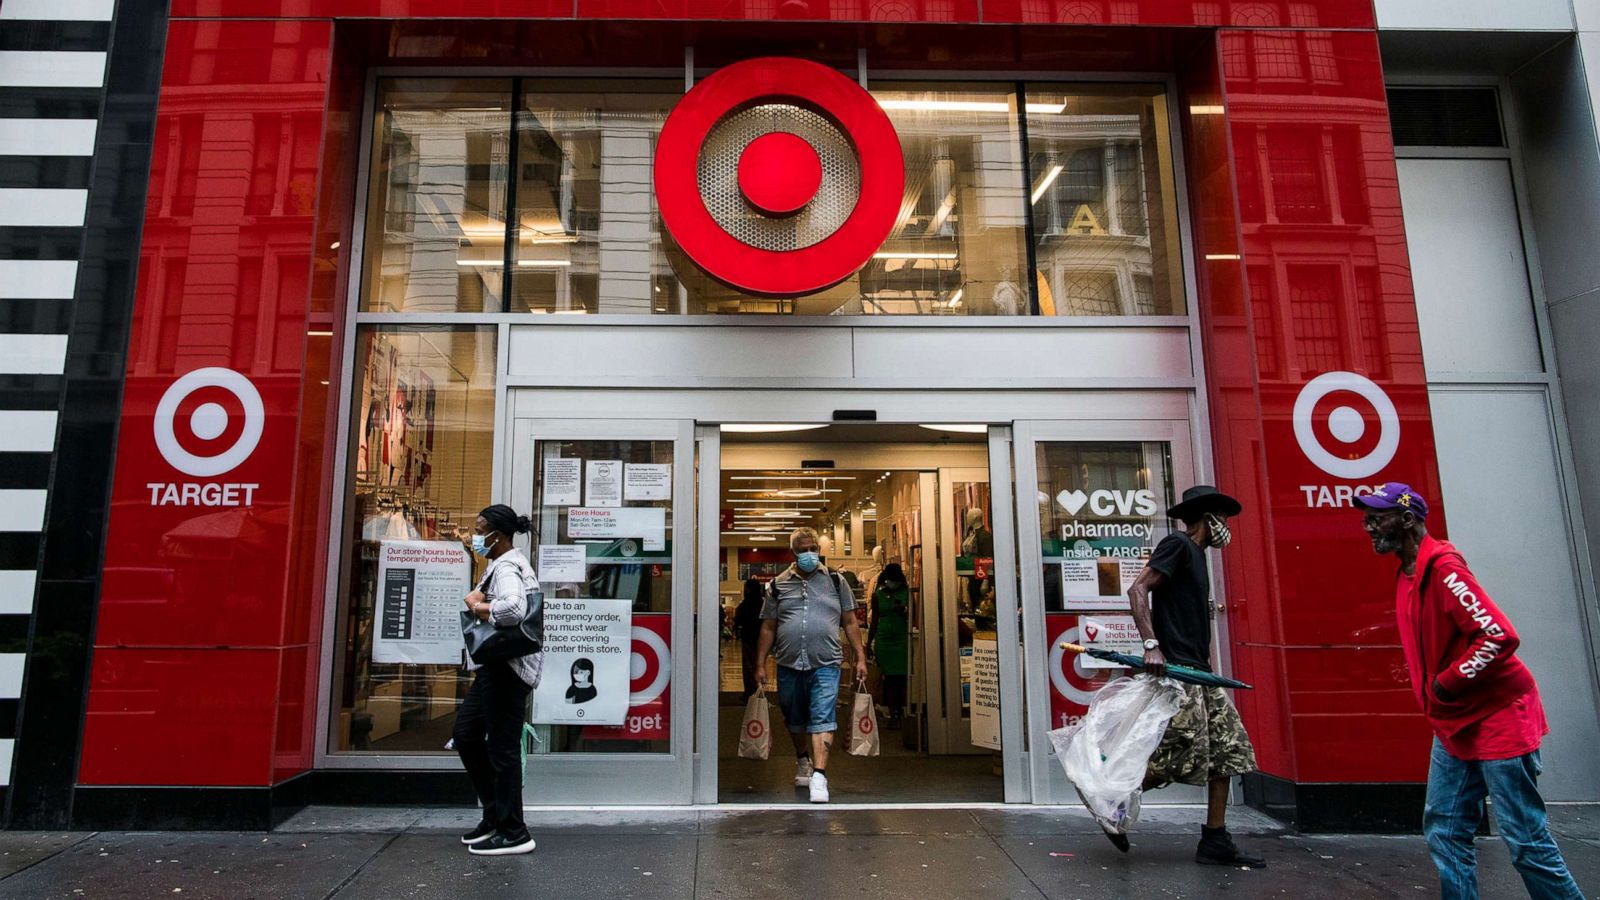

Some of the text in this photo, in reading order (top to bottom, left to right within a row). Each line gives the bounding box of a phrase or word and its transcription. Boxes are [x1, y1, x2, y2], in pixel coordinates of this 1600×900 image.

[147, 483, 259, 506] TARGET
[1090, 489, 1157, 516] CVS
[1300, 485, 1380, 507] TARG
[1062, 520, 1153, 541] pharmacy
[387, 555, 465, 564] temporarily changed.
[1063, 547, 1100, 558] inside
[543, 602, 560, 610] Due
[543, 613, 621, 622] emergency order,
[570, 634, 609, 644] covering
[1458, 640, 1502, 678] KORS
[606, 713, 662, 733] get
